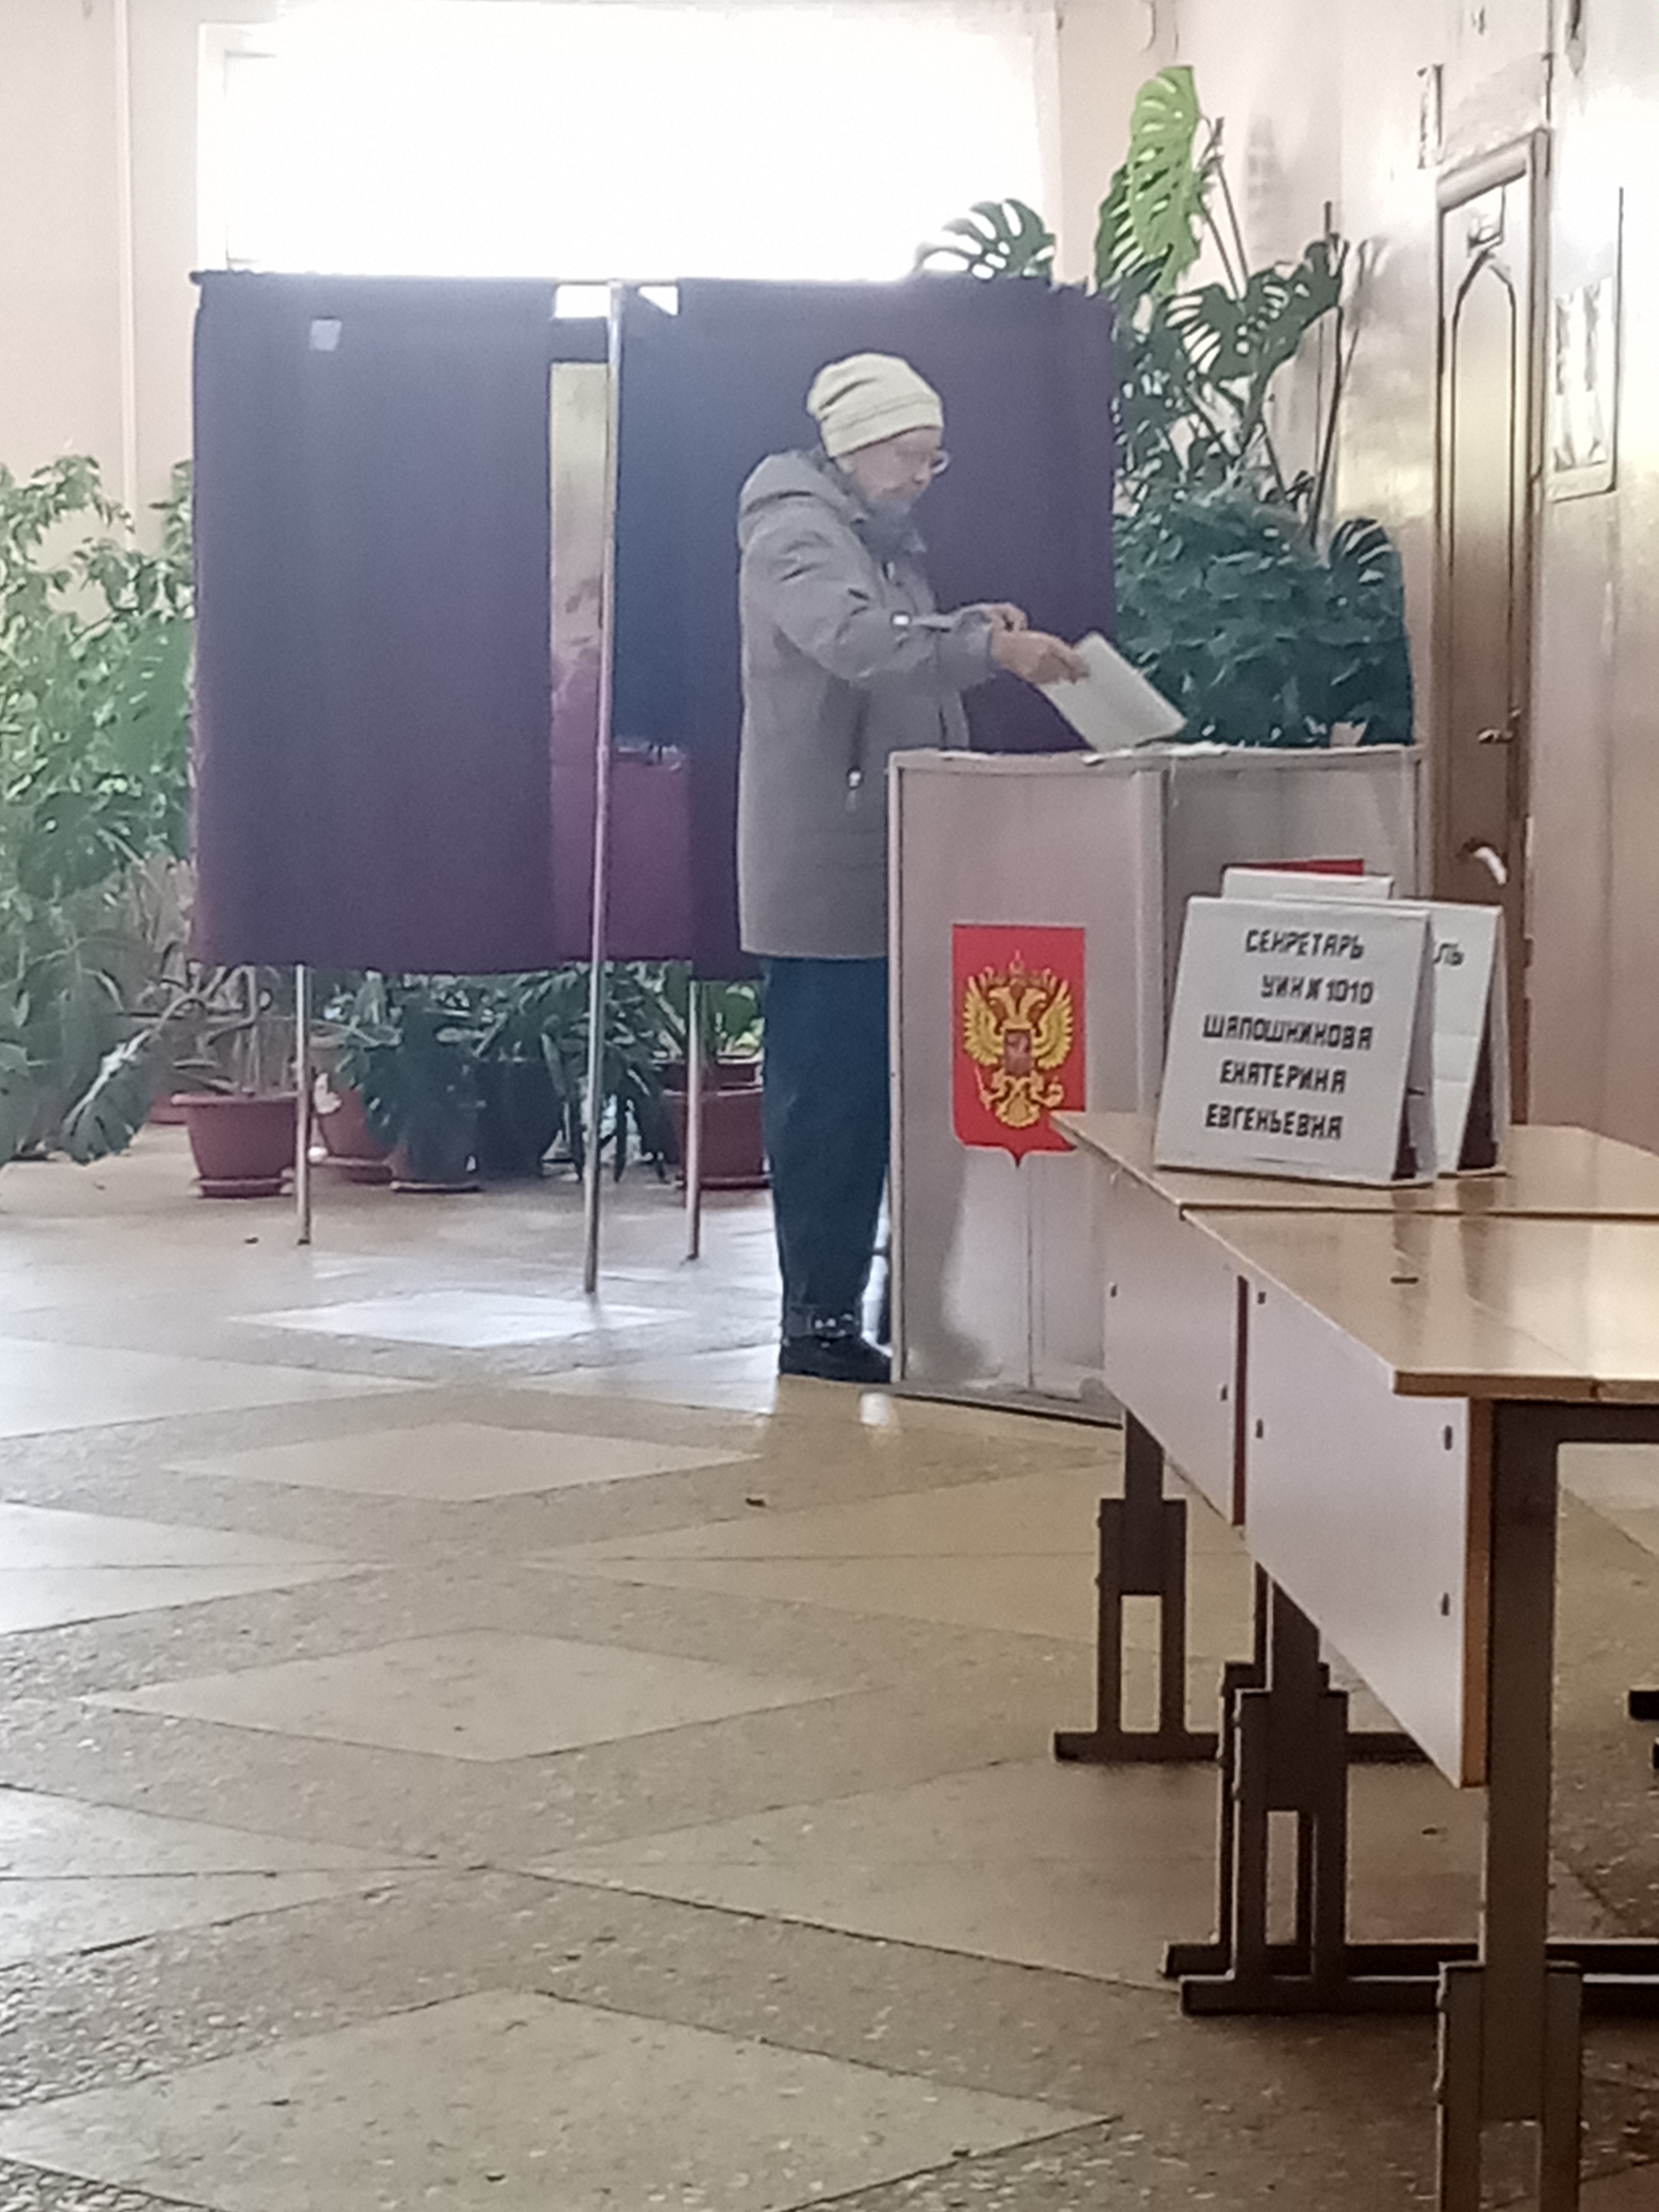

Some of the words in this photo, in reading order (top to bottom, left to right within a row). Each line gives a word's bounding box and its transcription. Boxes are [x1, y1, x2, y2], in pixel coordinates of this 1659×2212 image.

[1245, 929, 1364, 960] СЕКРЕТАРЬ
[1326, 979, 1374, 1005] 1010
[1202, 1014, 1374, 1051] ШАПОШНИКОВА
[1220, 1059, 1347, 1094] ЕКАТЕРИНА
[1205, 1103, 1343, 1141] ЕВГЕНЬЕВНА
